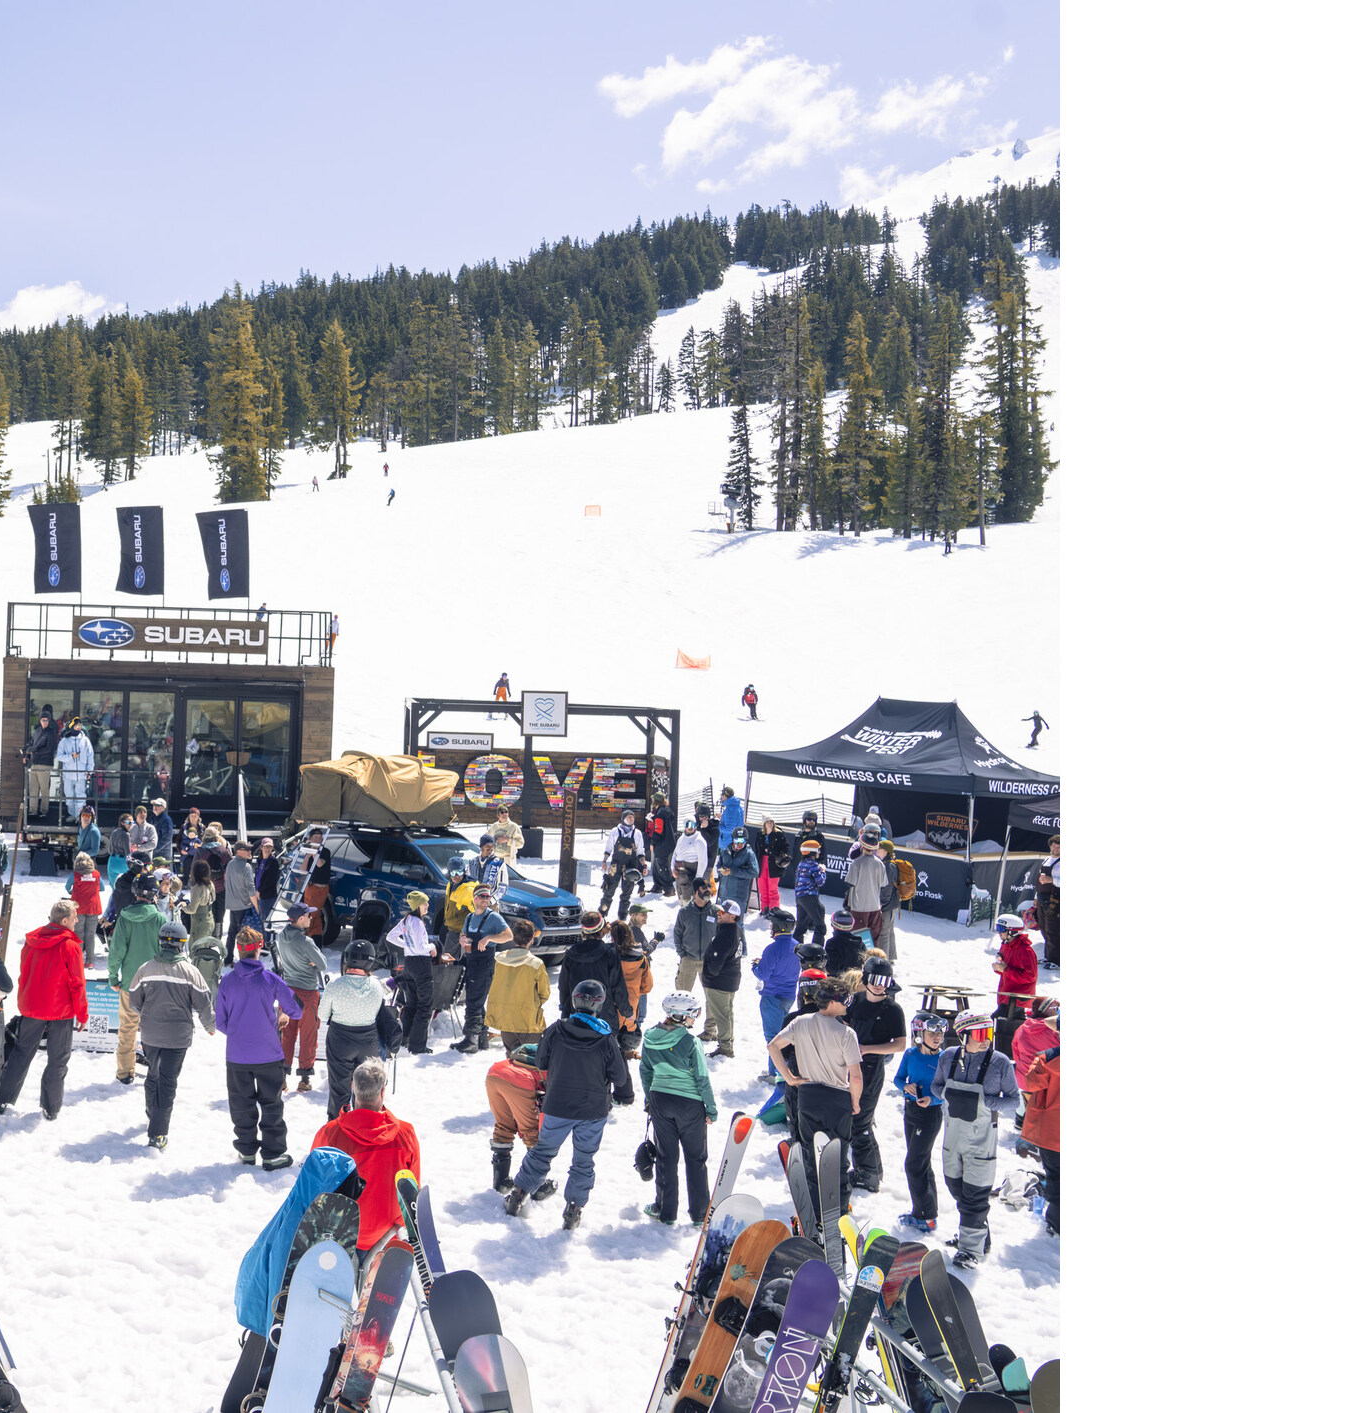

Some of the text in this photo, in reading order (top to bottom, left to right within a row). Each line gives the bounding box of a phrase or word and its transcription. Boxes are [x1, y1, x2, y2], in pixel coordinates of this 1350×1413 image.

[49, 512, 58, 561] SUBARU
[133, 514, 143, 563] SUBARU
[217, 518, 228, 566] SUBARU
[144, 626, 265, 646] SUBARU
[854, 730, 922, 747] WINTER
[862, 726, 893, 736] SUBARU
[451, 738, 489, 746] SUBARU
[866, 743, 913, 755] FEST
[794, 763, 912, 786] WILDERNESS CAFE
[988, 780, 1050, 795] WILDERNESS
[562, 795, 574, 851] OUTBACK
[927, 819, 969, 830] WILDERNES
[936, 815, 967, 825] SUBARU
[827, 859, 853, 871] WINT
